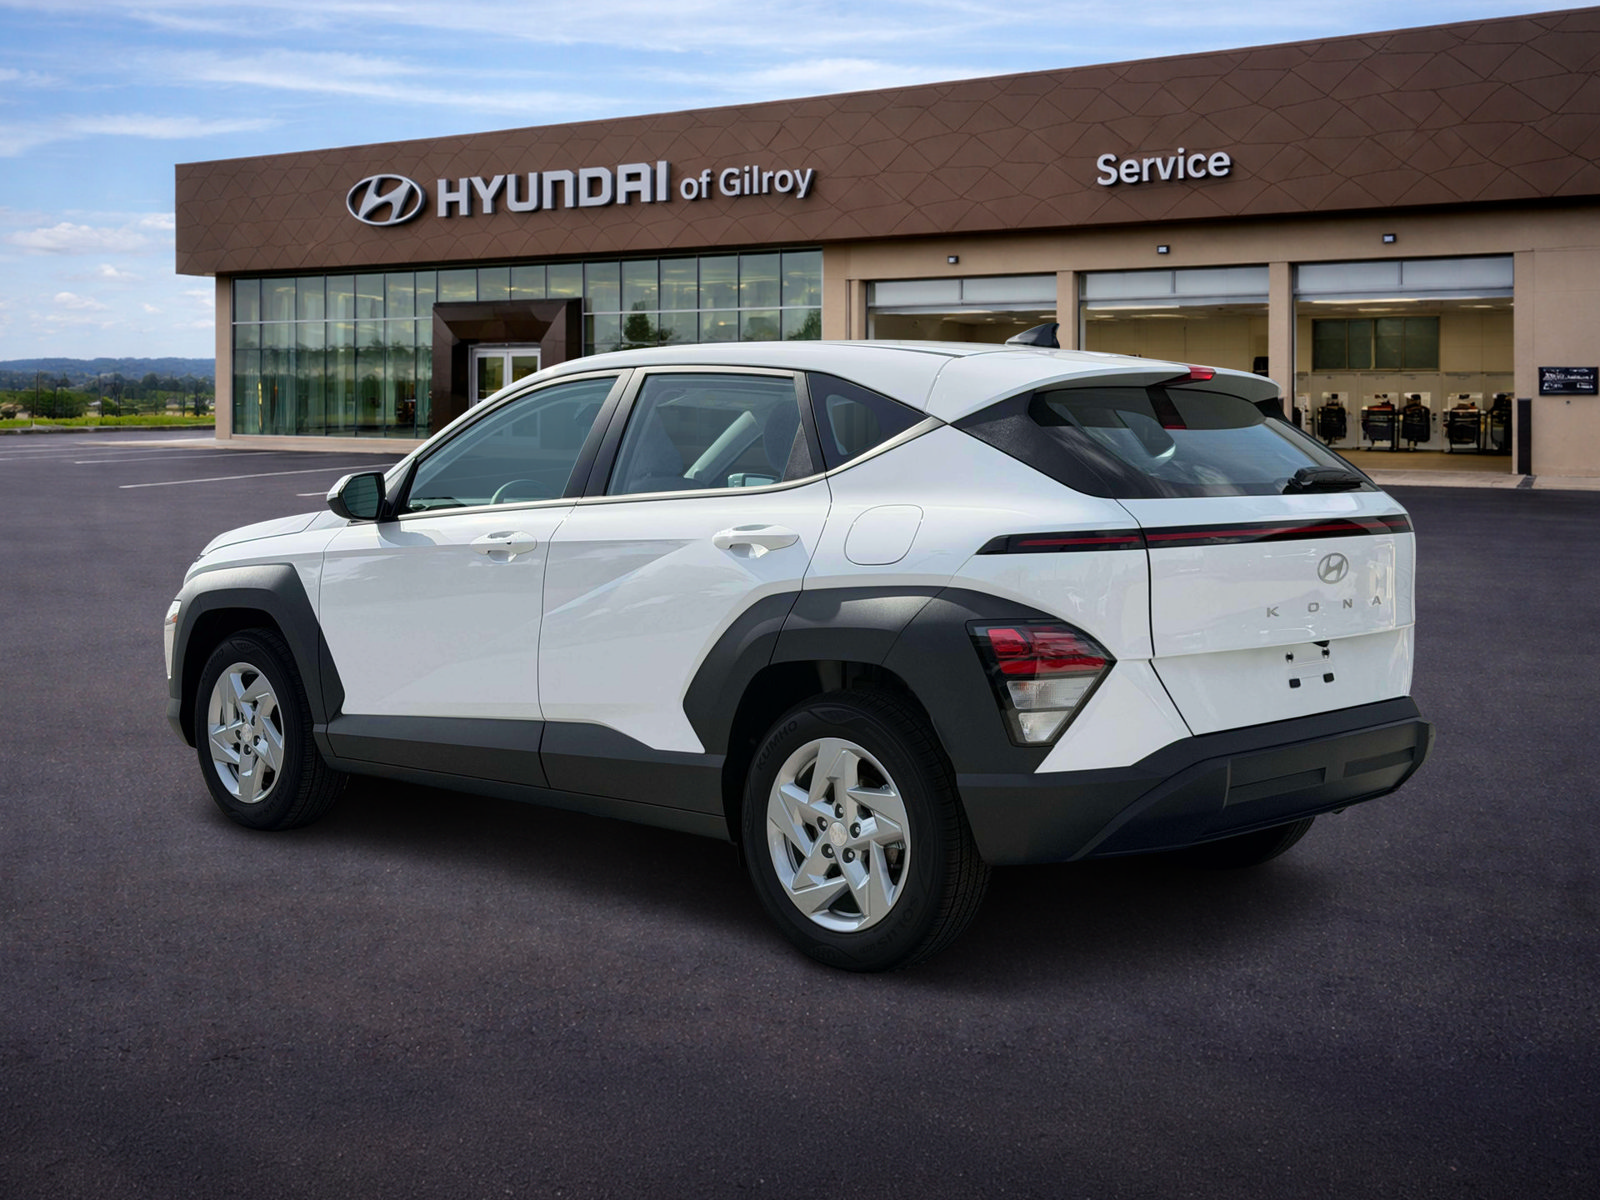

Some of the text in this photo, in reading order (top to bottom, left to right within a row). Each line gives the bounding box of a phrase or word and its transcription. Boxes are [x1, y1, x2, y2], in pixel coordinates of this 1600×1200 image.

[437, 160, 814, 218] HYUNDAI of Gilroy
[1096, 147, 1231, 187] Service
[1266, 595, 1382, 618] KONA
[756, 720, 798, 770] KUMHO
